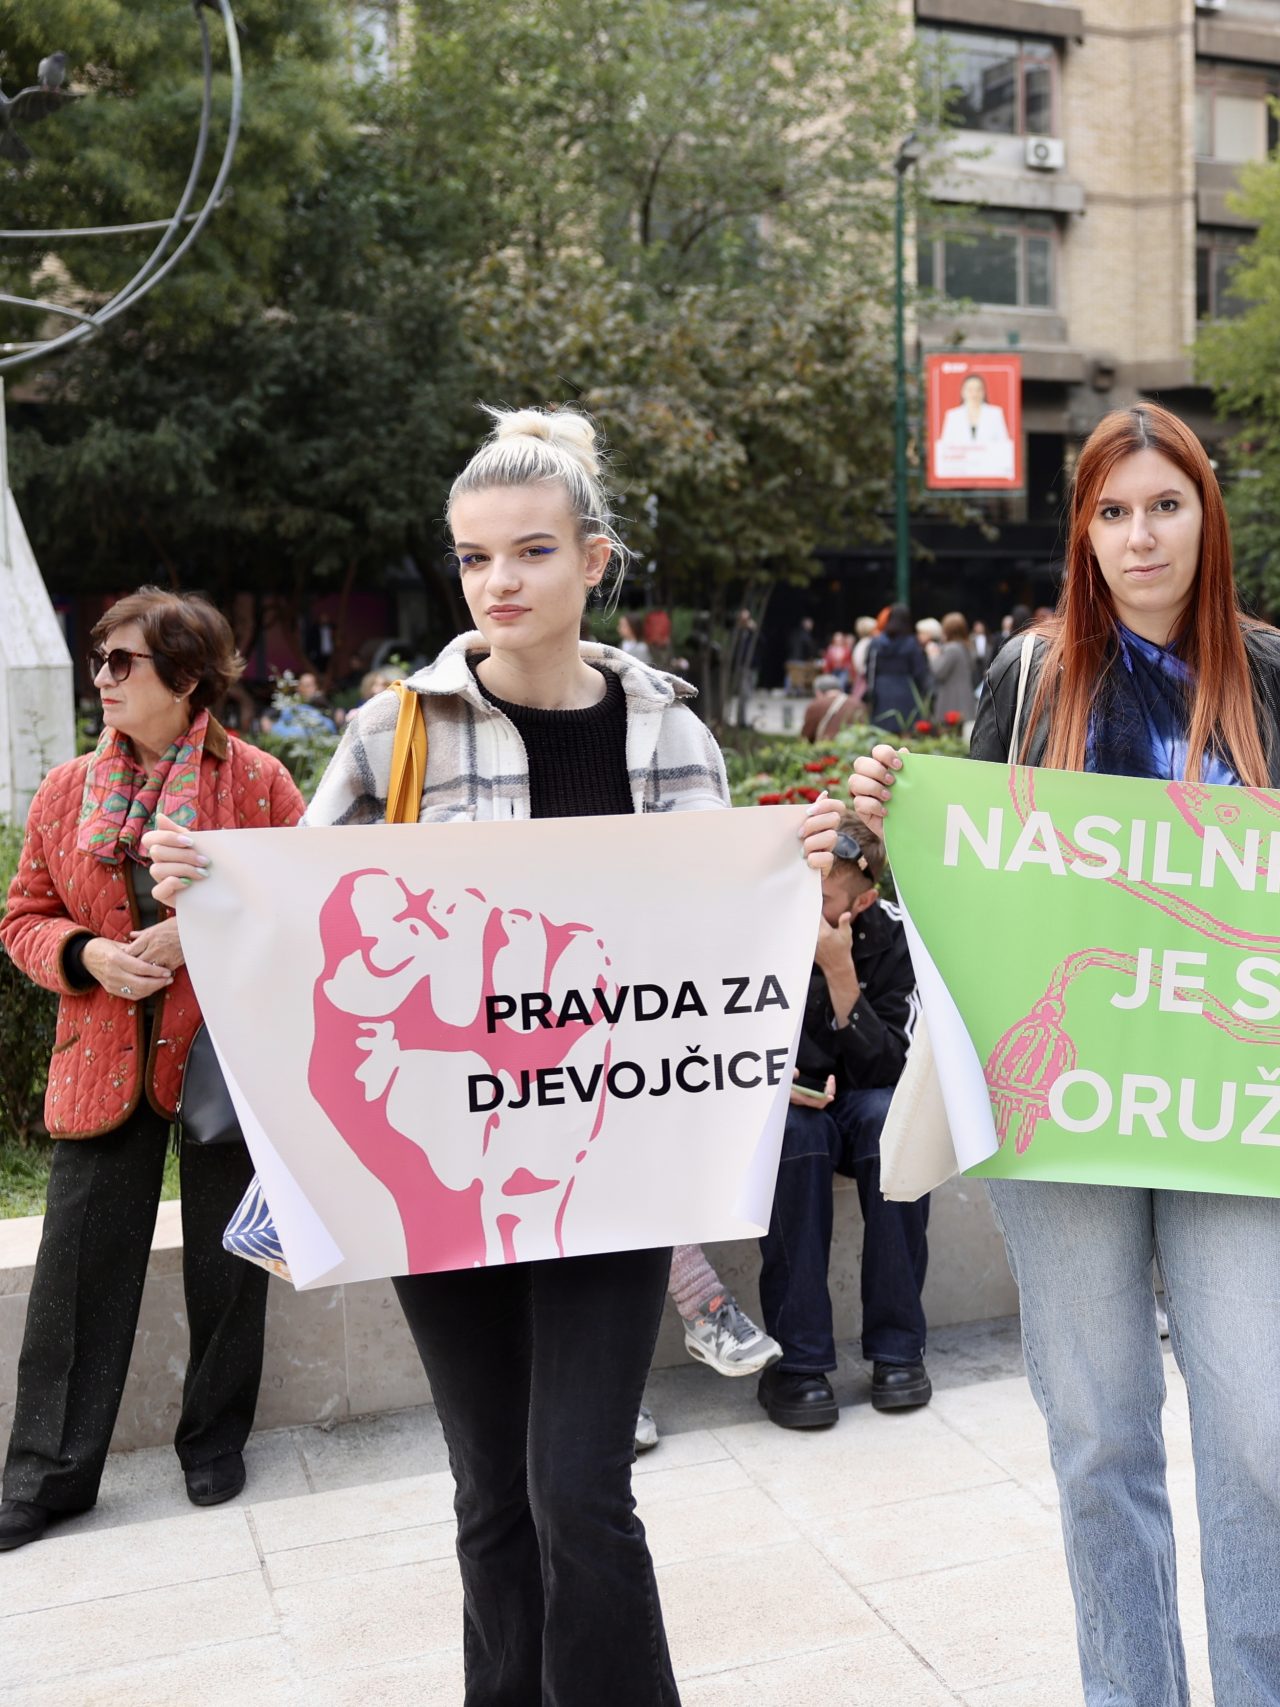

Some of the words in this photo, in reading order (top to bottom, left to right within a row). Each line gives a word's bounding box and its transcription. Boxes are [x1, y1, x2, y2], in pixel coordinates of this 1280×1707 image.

[485, 980, 708, 1033] PRAVDA
[722, 974, 790, 1014] ZA
[1110, 947, 1208, 1014] JE
[467, 1044, 789, 1112] DJEVOJČICE
